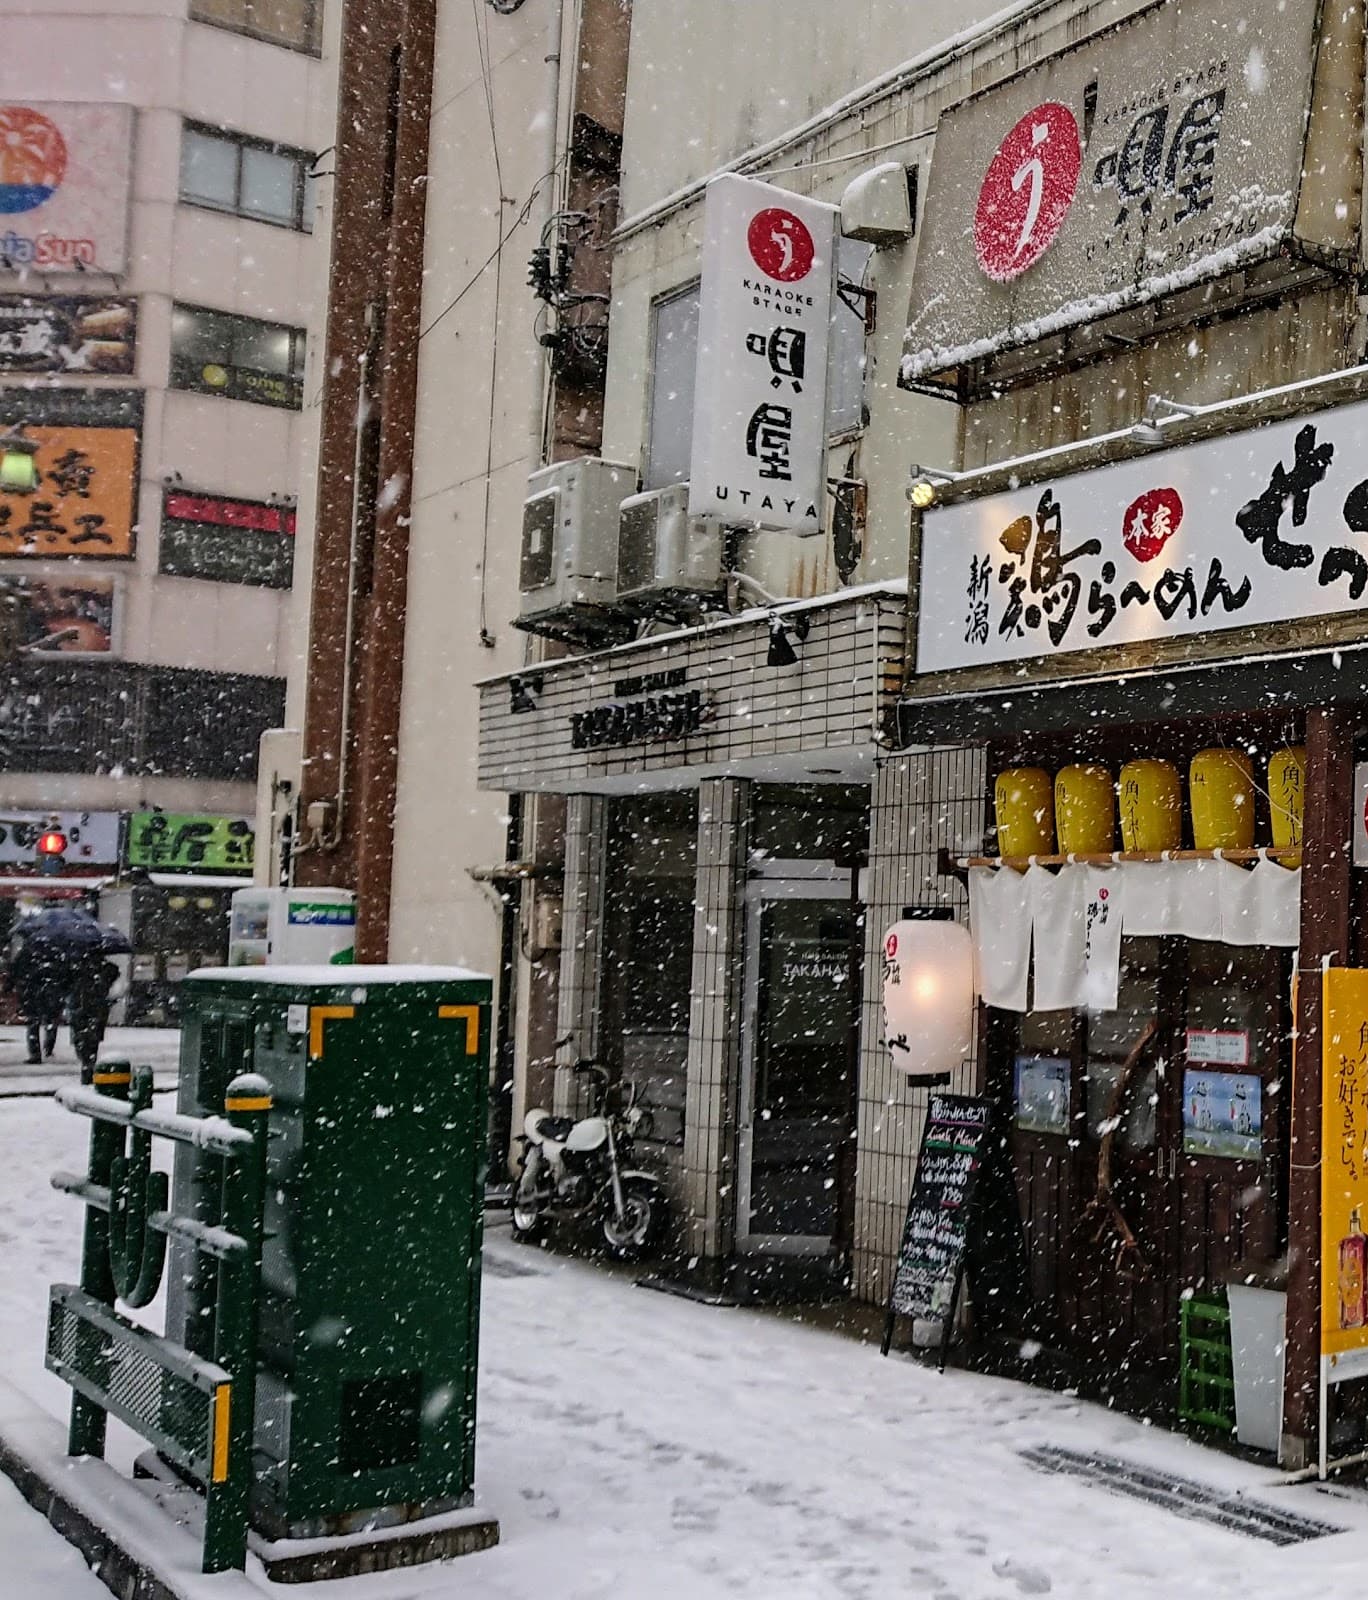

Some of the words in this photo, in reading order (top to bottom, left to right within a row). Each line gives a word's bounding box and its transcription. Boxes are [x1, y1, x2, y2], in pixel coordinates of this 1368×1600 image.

[1093, 87, 1227, 227] 唄屋
[743, 279, 814, 307] KARAOKE
[753, 297, 804, 318] STAGE
[745, 325, 808, 482] 唄屋
[715, 485, 818, 519] UTAYA
[1127, 503, 1172, 547] 本家
[964, 553, 993, 646] 新潟
[1281, 765, 1303, 848] 角ハイボール
